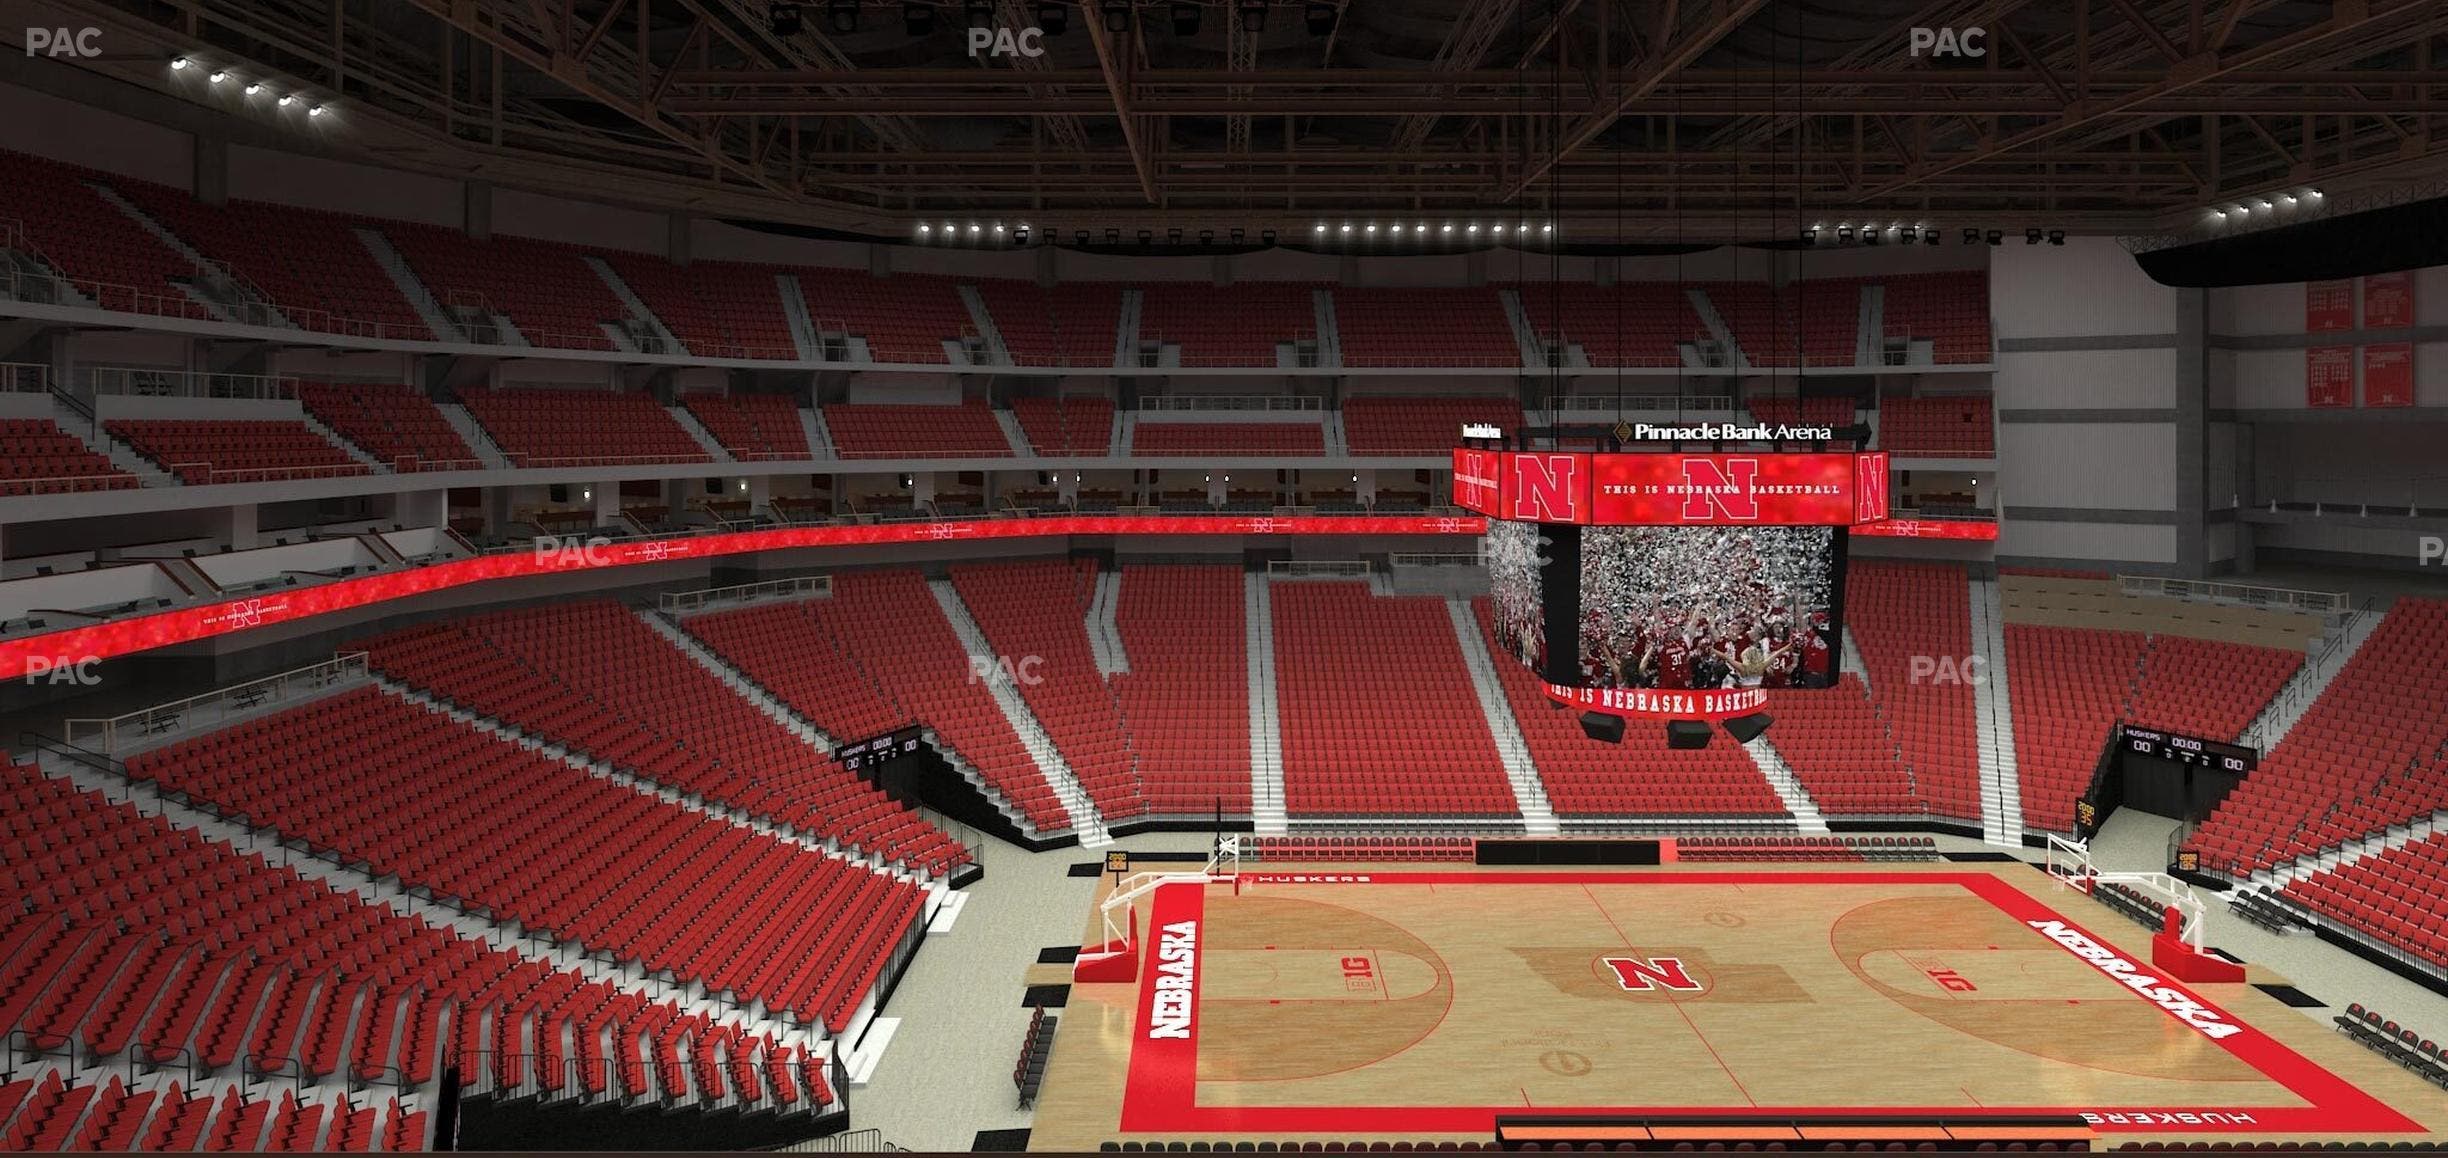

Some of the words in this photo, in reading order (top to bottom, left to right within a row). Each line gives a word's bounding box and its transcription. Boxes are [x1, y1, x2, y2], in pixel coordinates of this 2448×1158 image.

[1635, 423, 1720, 440] Pinnacle
[1722, 423, 1772, 440] Bank
[1774, 423, 1832, 440] Arena
[1516, 455, 1574, 521] N
[1604, 485, 1636, 494] THIS
[1645, 485, 1658, 494] IS
[1667, 485, 1741, 494] NEBRASKA
[1751, 485, 1840, 494] BASKETBALL
[1683, 458, 1757, 519] N
[1860, 455, 1883, 521] N
[233, 599, 260, 628] N
[1580, 688, 1594, 704] IS
[1602, 689, 1695, 713] NEBRASKA
[2127, 729, 2160, 740] HUSKERS
[2224, 757, 2243, 771] 00
[1150, 920, 1197, 1039] NEBRASKA
[1602, 957, 1703, 991] N
[2027, 920, 2243, 1039] NEBRASKA
